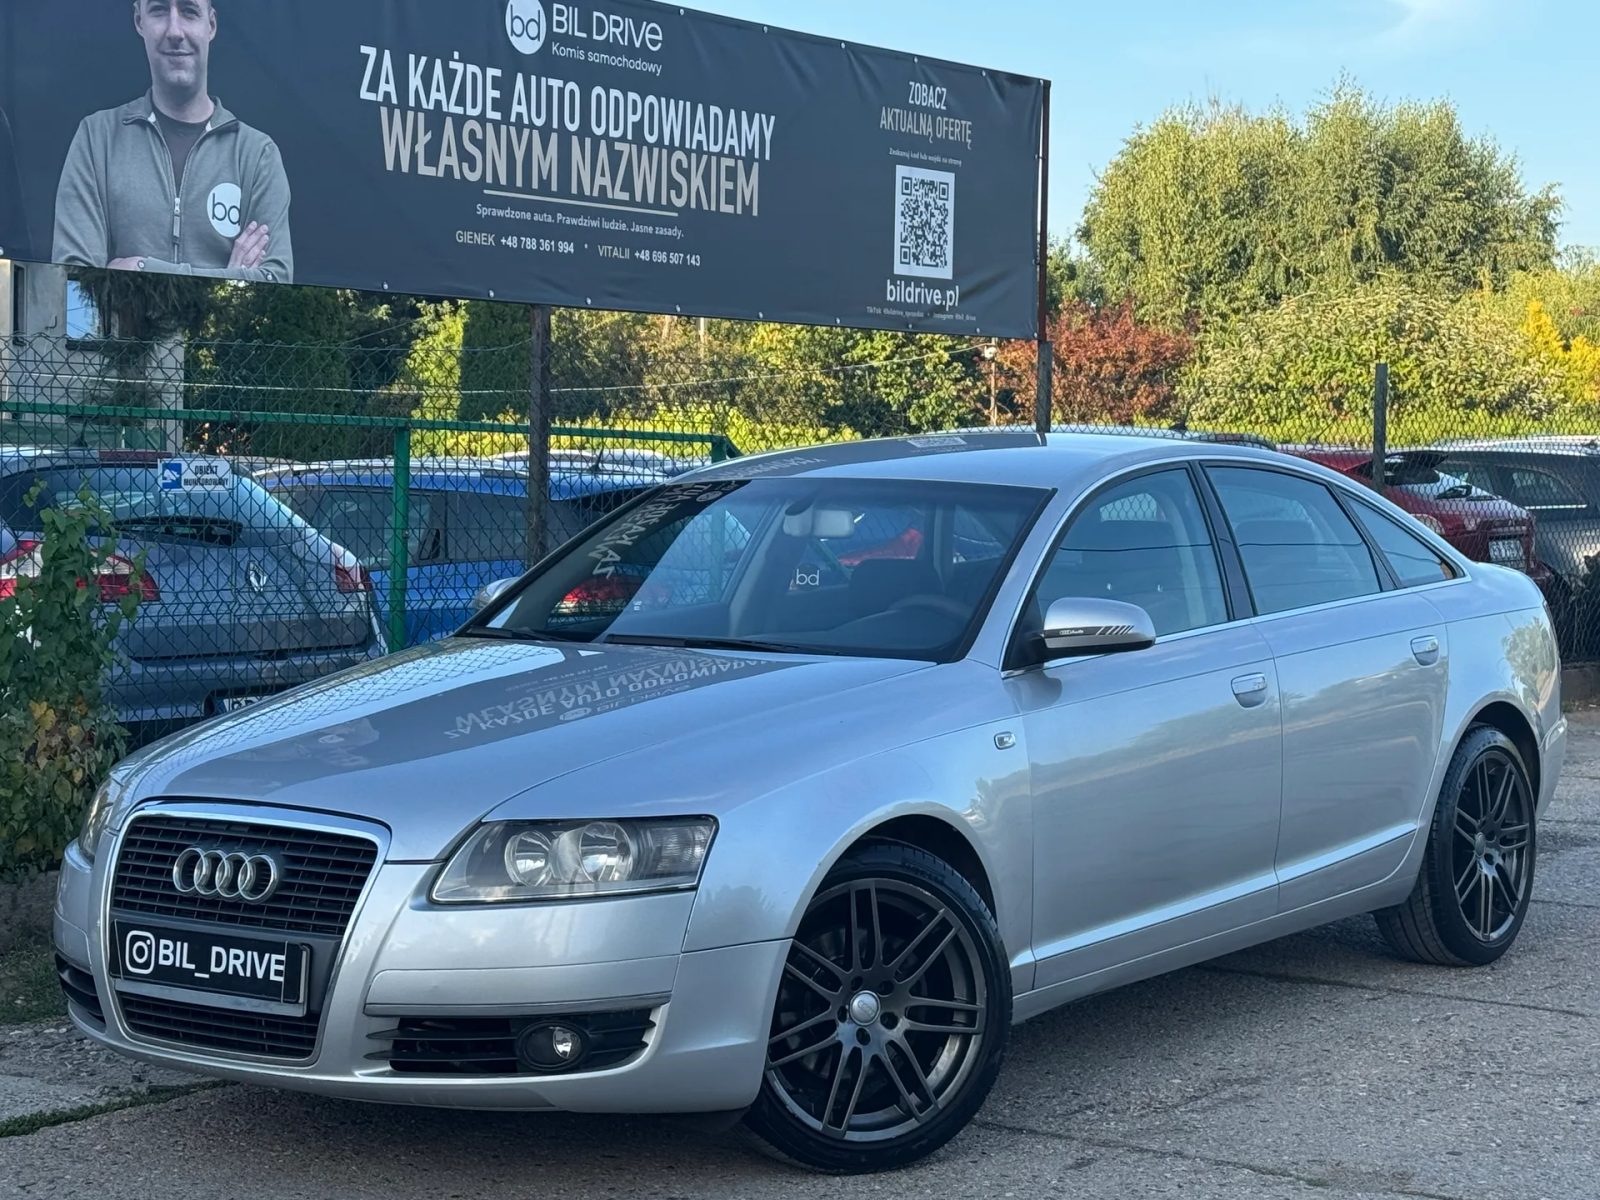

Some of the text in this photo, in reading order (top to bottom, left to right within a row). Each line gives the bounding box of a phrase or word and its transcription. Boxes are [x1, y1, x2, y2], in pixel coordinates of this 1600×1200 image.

[552, 3, 588, 38] BIL
[552, 42, 662, 77] Komis samochodowy
[359, 45, 776, 161] ZA KAŻDE AUTO ODPOWIADAMY
[908, 81, 947, 110] ZOBACZ
[879, 106, 973, 150] AKTUALNĄ OFERTĘ
[379, 106, 760, 217] WŁASNYM NAZWISKIEM
[475, 203, 684, 239] Sprawdzone auta. Prawdziwi ludzie. Jasne zasady.
[455, 230, 574, 254] GIENEK +48 788 361 994
[597, 244, 701, 267] VITALII +48 696 507 143
[886, 279, 959, 312] bildrive.pl
[796, 568, 820, 586] bd
[158, 938, 285, 982] BIL_DRIVE
